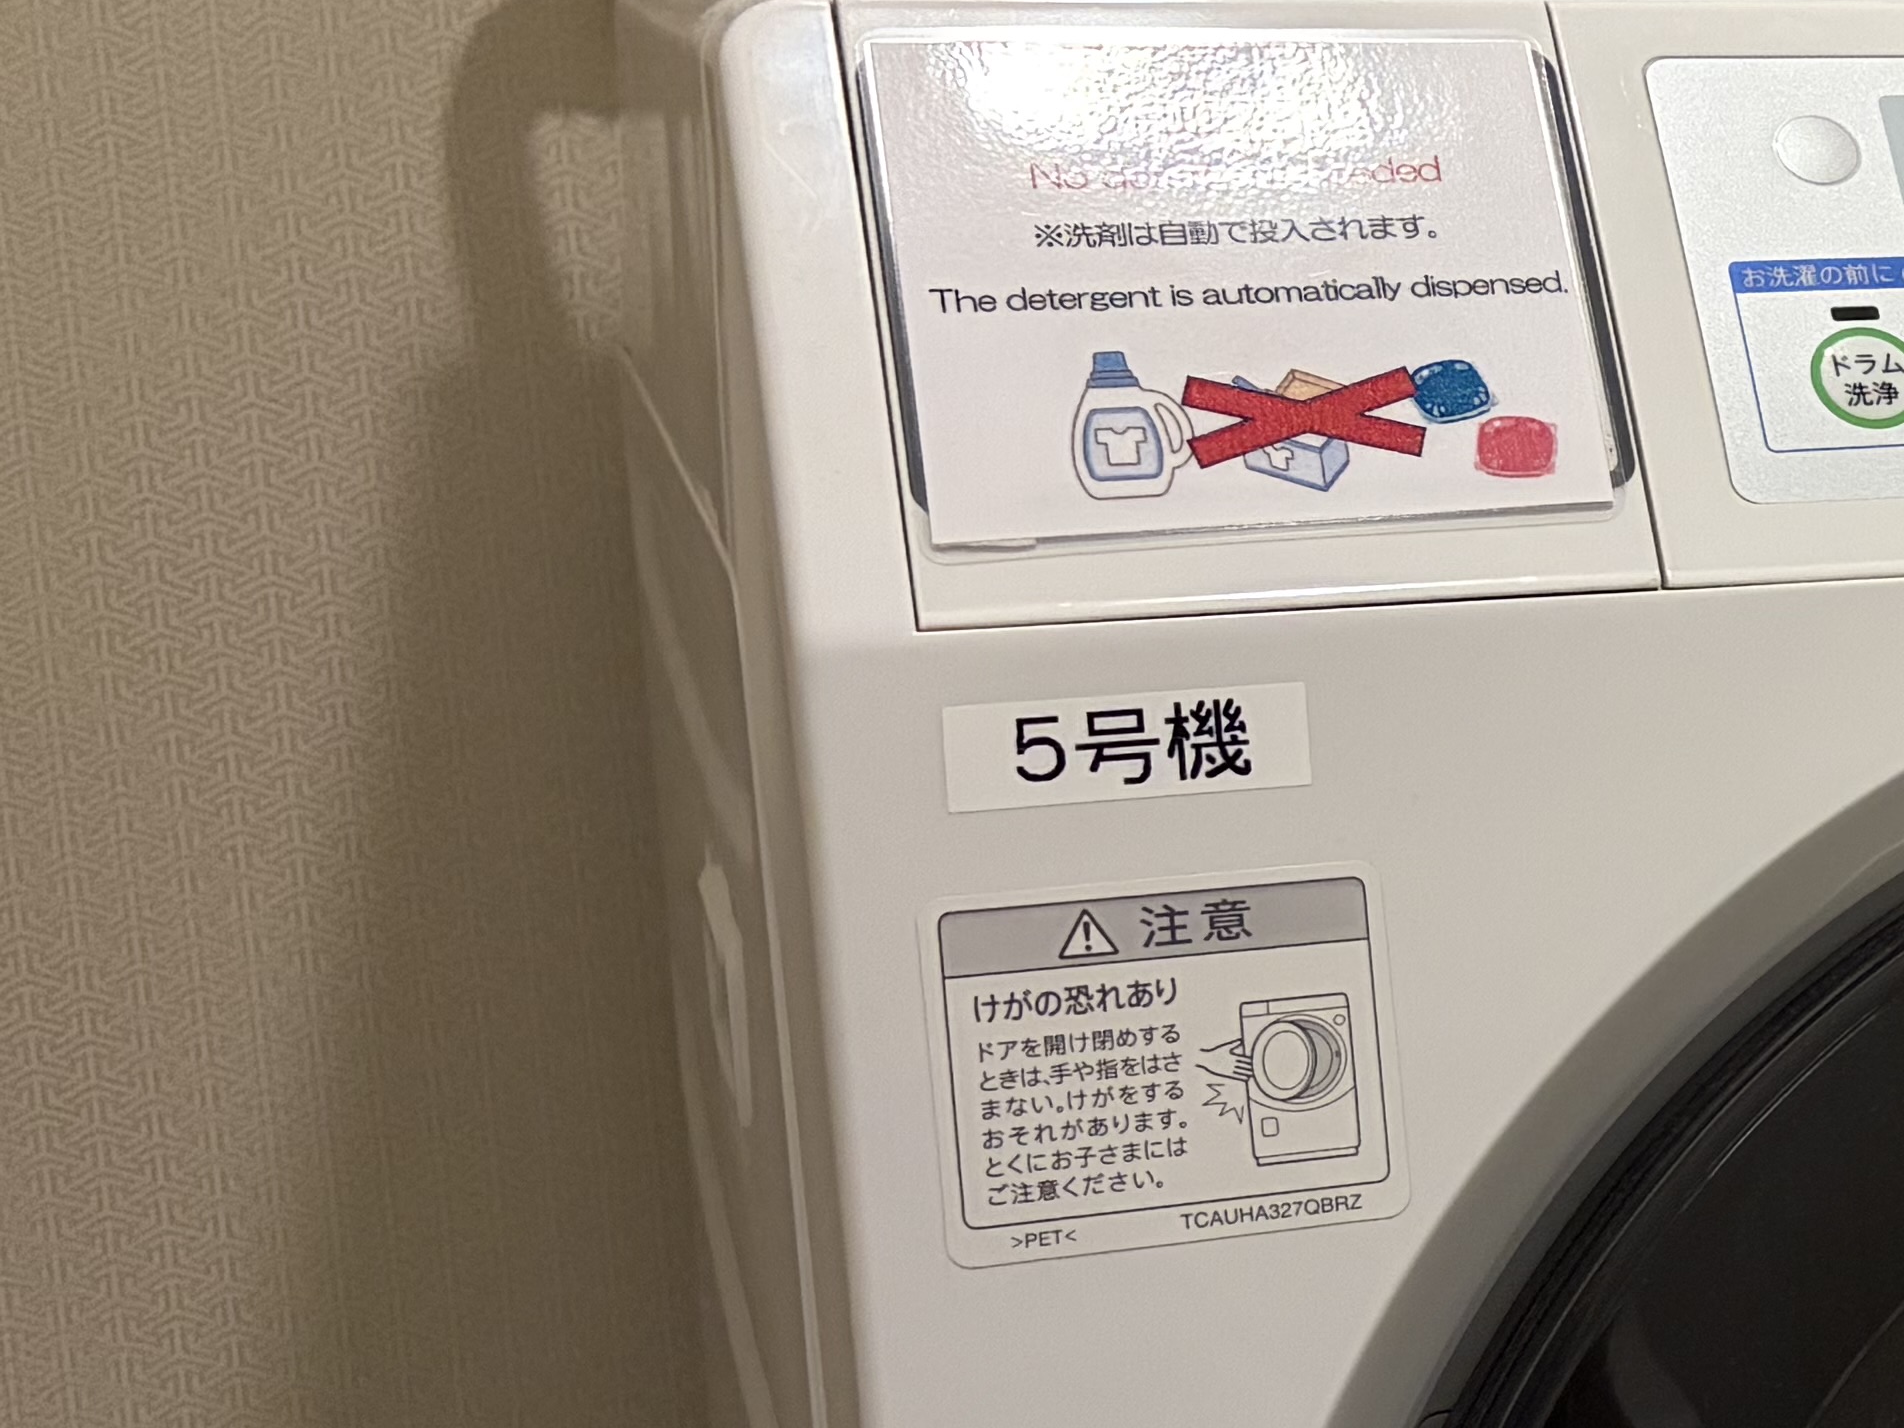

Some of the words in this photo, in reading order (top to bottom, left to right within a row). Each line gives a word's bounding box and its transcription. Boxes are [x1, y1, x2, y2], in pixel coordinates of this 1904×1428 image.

[928, 287, 998, 314] The
[1005, 283, 1161, 313] detergent
[1169, 283, 1195, 308] is
[1201, 276, 1403, 308] automatically
[1410, 269, 1570, 304] dispensed.
[1742, 265, 1896, 289] お洗濯の前に
[1843, 380, 1900, 408] 洗浄
[1014, 697, 1253, 785] 5号機
[1139, 898, 1253, 948] 注意
[973, 976, 1179, 1024] けがの恐れあり
[976, 1022, 1182, 1064] ドアを開け閉めする
[978, 1052, 1183, 1094] ときは、手や指をはさ
[980, 1082, 1186, 1121] まない。けがをする
[982, 1110, 1190, 1150] おそれがあります。
[984, 1136, 1189, 1178] とくにお子さまには
[987, 1170, 1167, 1207] ご注意ください。
[1180, 1193, 1363, 1232] TCAUHA327QBRZ
